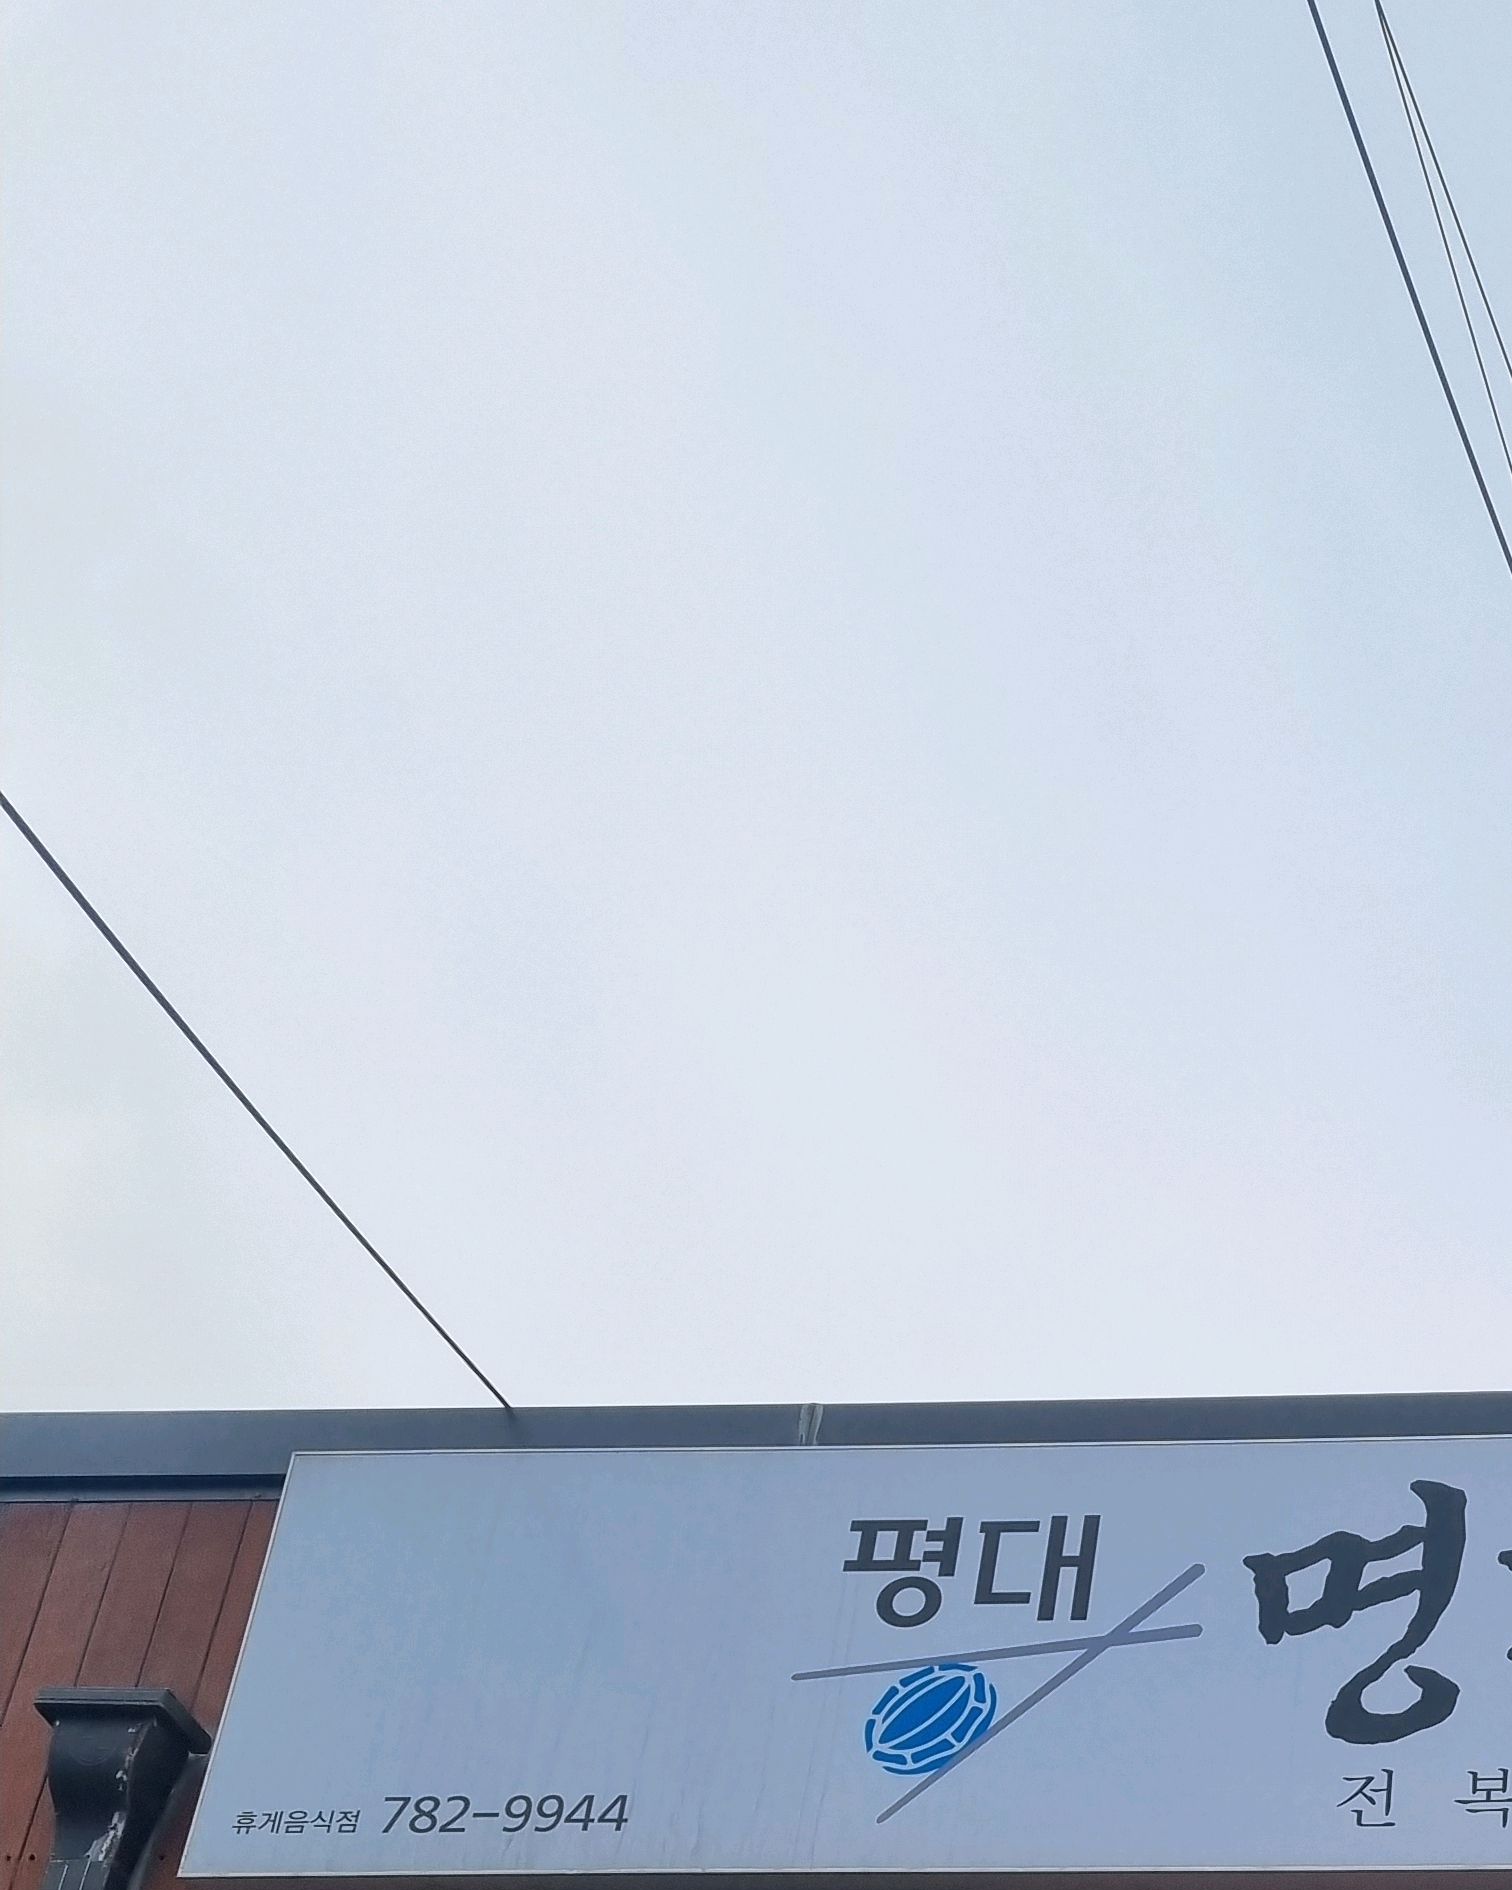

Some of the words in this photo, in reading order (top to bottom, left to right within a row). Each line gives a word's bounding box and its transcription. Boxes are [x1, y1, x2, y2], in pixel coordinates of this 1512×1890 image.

[841, 1513, 1102, 1629] 평대
[231, 1808, 361, 1836] 휴게음식점
[381, 1793, 630, 1835] 782-9944
